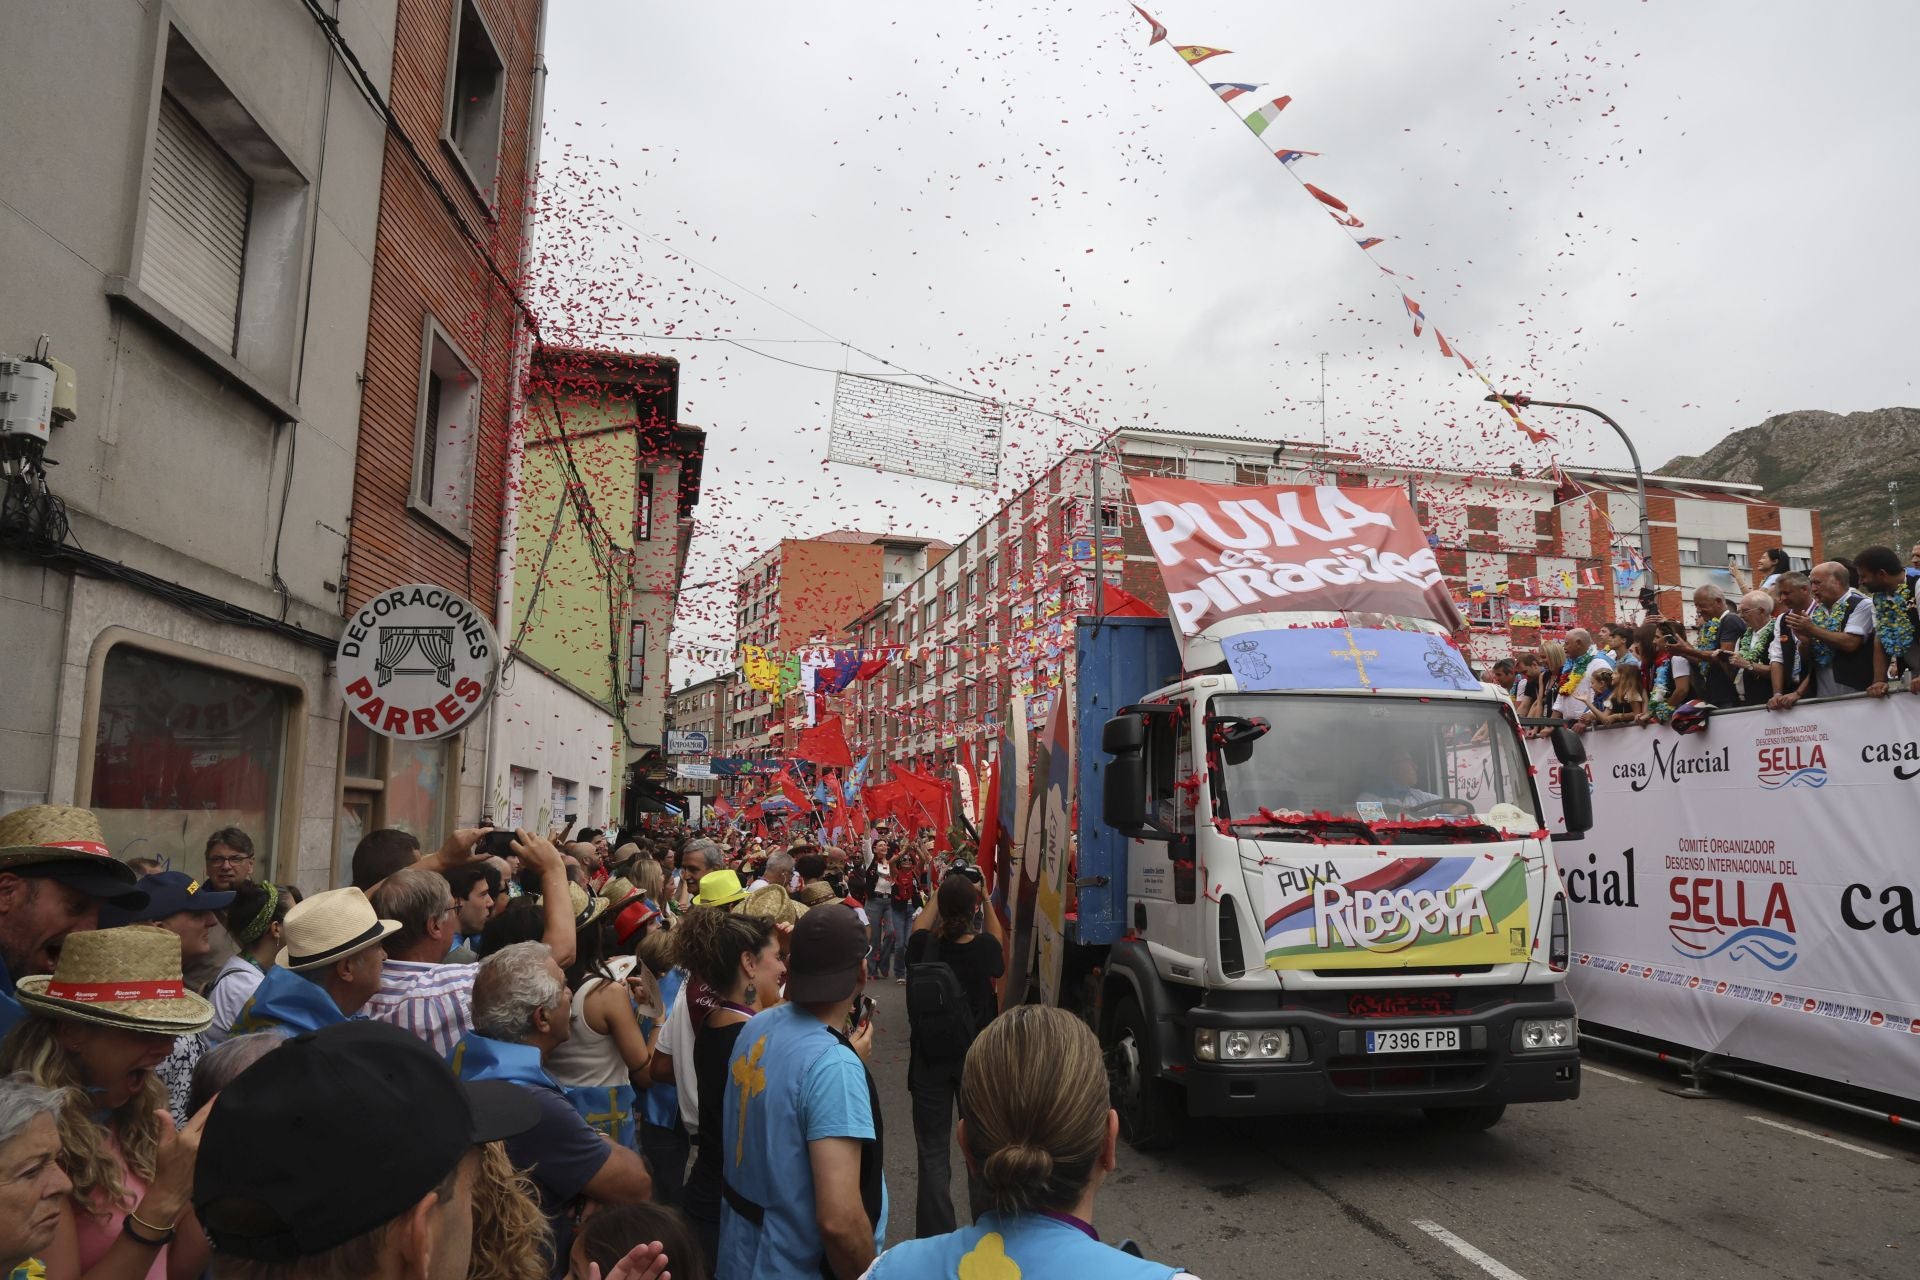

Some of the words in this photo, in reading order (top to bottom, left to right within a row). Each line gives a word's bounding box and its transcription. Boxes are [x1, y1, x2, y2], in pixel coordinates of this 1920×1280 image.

[1137, 486, 1397, 567] PUXA
[342, 588, 488, 660] DECORACIONES
[345, 676, 482, 735] PARRES
[1756, 738, 1780, 747] DESCENSO
[1780, 735, 1818, 744] INTERNACIONAL
[1783, 725, 1818, 735] ORGANIZADOR
[1612, 762, 1647, 778] casa
[1631, 738, 1731, 792] Marcial
[1758, 744, 1827, 772] SELLA
[1861, 741, 1920, 763] casa
[1678, 836, 1709, 853] COMITÉ
[1710, 838, 1776, 854] ORGANIZADOR
[1278, 860, 1341, 896] PUXA
[1560, 847, 1639, 908] cial
[1665, 855, 1705, 871] DESCENSO
[1707, 857, 1777, 875] INTERNACIONAL
[1779, 861, 1798, 876] DEL
[1669, 876, 1796, 933] SELLA
[1377, 1032, 1420, 1051] 7396
[1425, 1031, 1456, 1048] FPB
